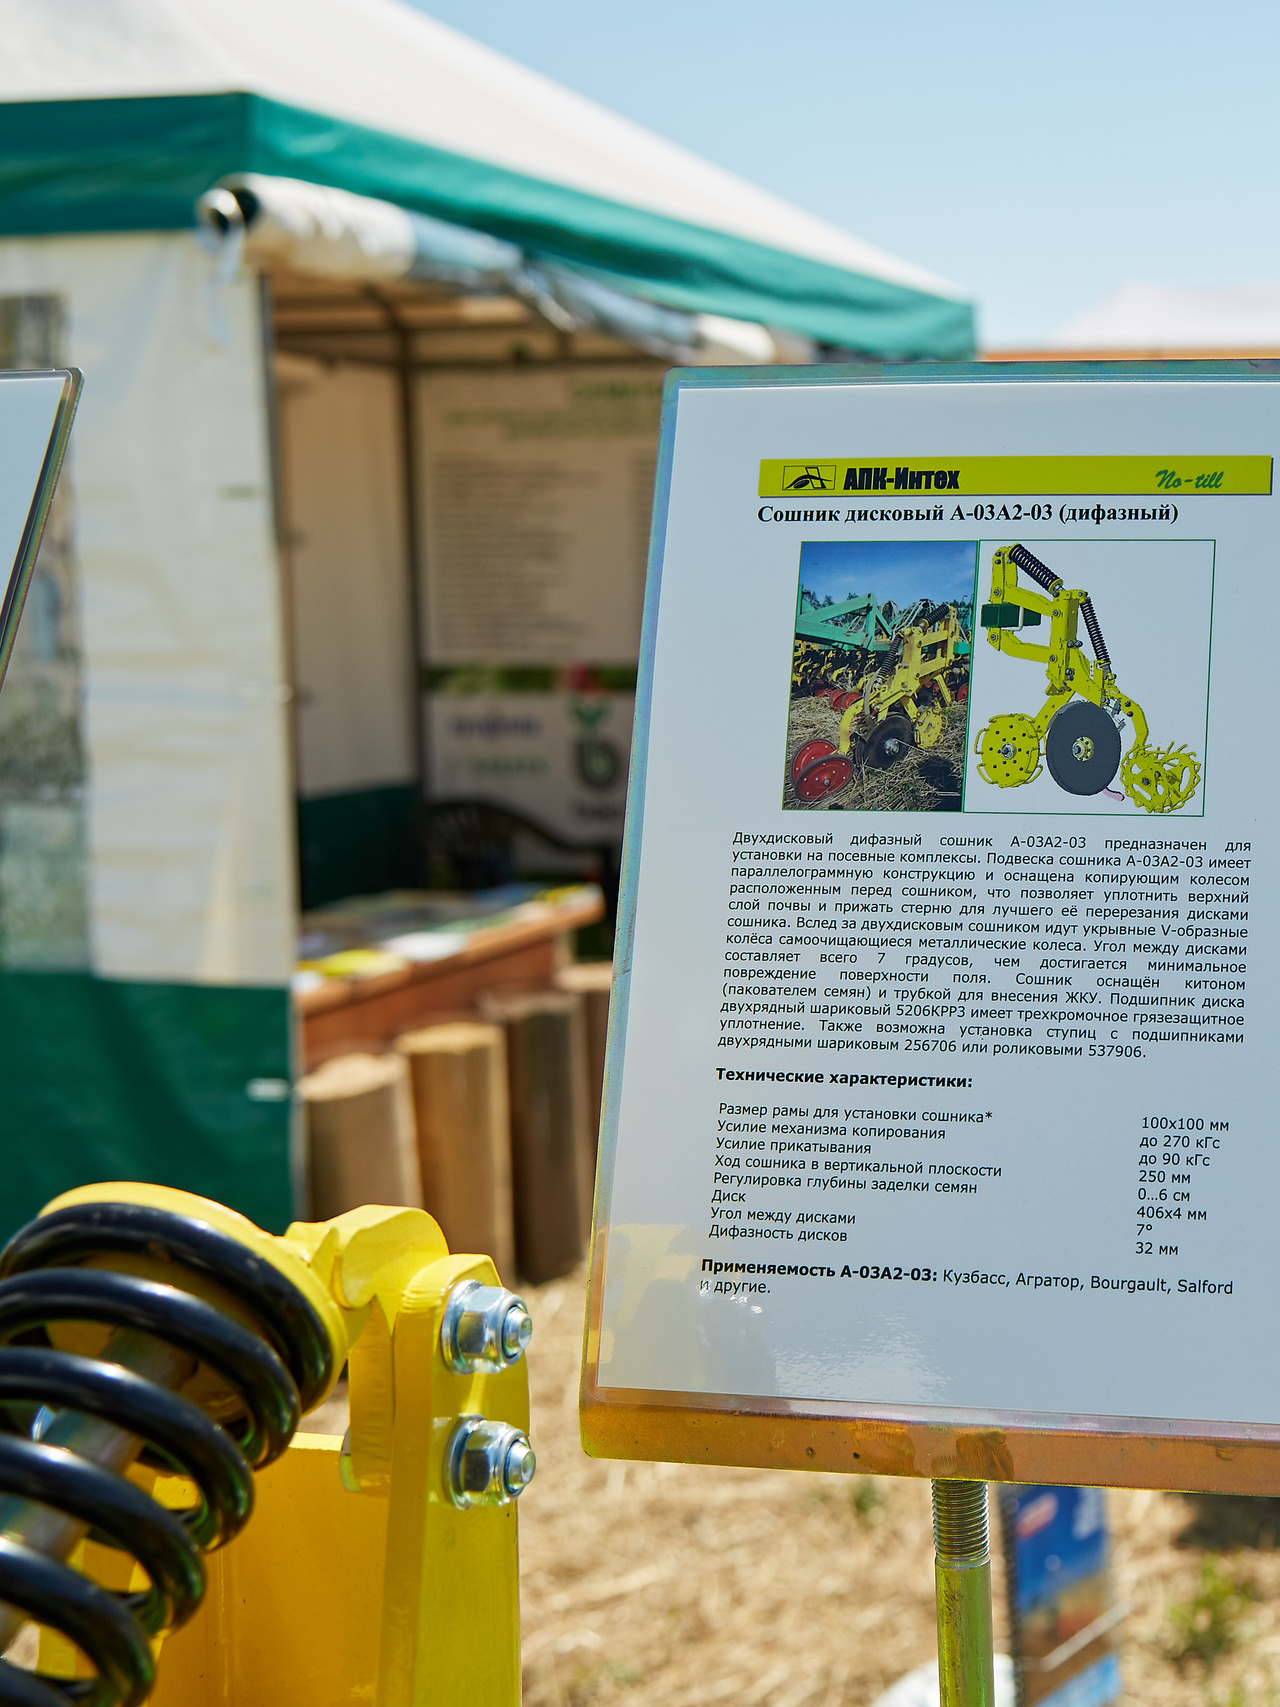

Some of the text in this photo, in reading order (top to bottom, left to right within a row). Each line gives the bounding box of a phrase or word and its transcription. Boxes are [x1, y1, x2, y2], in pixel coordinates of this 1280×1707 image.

[843, 467, 960, 490] АПК-Интех
[1155, 469, 1224, 490] No-till
[758, 504, 1178, 525] Сошник дисковый А-03А2-03 (дифазный)
[732, 832, 1251, 853] Двухдисковый дифазный сошник А-03А2-03 предназначен для
[730, 884, 1249, 905] расположенным перед сошником, что позволяет уплотнить верхний
[724, 968, 1245, 990] повреждение поверхности поля. Сошник оснащён китоном
[717, 1037, 1146, 1058] двухрядными шариковым 256706 или роликовыми 537906.
[716, 1068, 972, 1089] Технические характеристики:
[718, 1120, 945, 1140] Усилие механизма копирования
[716, 1137, 871, 1154] Усилие прикатывания
[1139, 1135, 1220, 1149] до 270 кГс
[715, 1154, 1001, 1177] Ход сошника в вертикальной плоскости
[1138, 1152, 1210, 1166] до 90 кГс
[714, 1172, 977, 1193] Регулировка глубины заделки семян
[1139, 1170, 1190, 1184] 250 мм
[711, 1189, 746, 1204] Диск
[711, 1207, 855, 1224] Угол между дисками
[708, 1224, 847, 1242] Дифазность дисков
[1135, 1241, 1178, 1255] 32 мм
[701, 1259, 1233, 1295] Применяемость А-03А2-03: Кузбасс, Агратор, Bourgault, Salford
[713, 1281, 770, 1295] другие.
